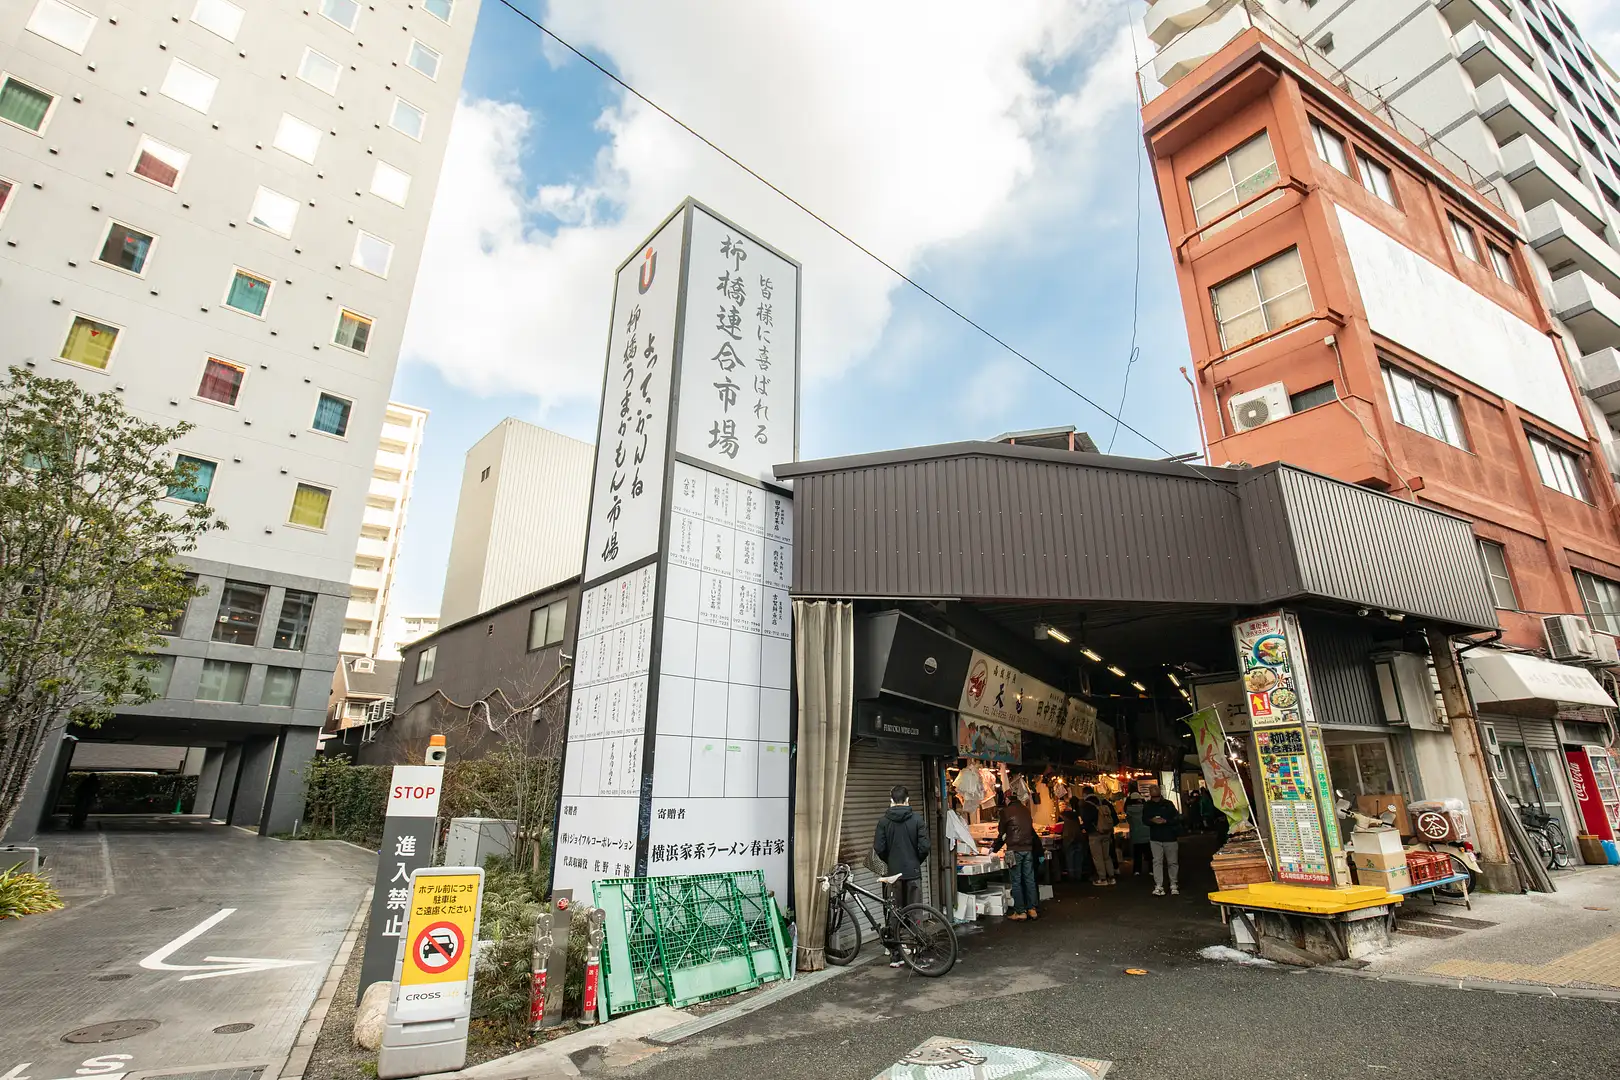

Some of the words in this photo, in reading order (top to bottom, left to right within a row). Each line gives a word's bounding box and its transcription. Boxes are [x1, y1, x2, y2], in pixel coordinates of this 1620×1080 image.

[708, 234, 747, 460] 柳橋連合市場
[753, 273, 774, 445] 皆様に喜ばれる
[601, 303, 642, 563] 柳橋うまかもん市場
[393, 786, 436, 799] STOP
[657, 808, 686, 820] 寄贈者
[1424, 815, 1446, 836] 茶
[651, 838, 785, 863] 横浜家系ラーメン春吉家
[382, 835, 417, 937] 進入禁止
[418, 884, 474, 895] ホテル前につき
[433, 894, 457, 905] 駐車は
[416, 904, 472, 916] ご遠慮ください
[405, 991, 441, 1002] CROSS
